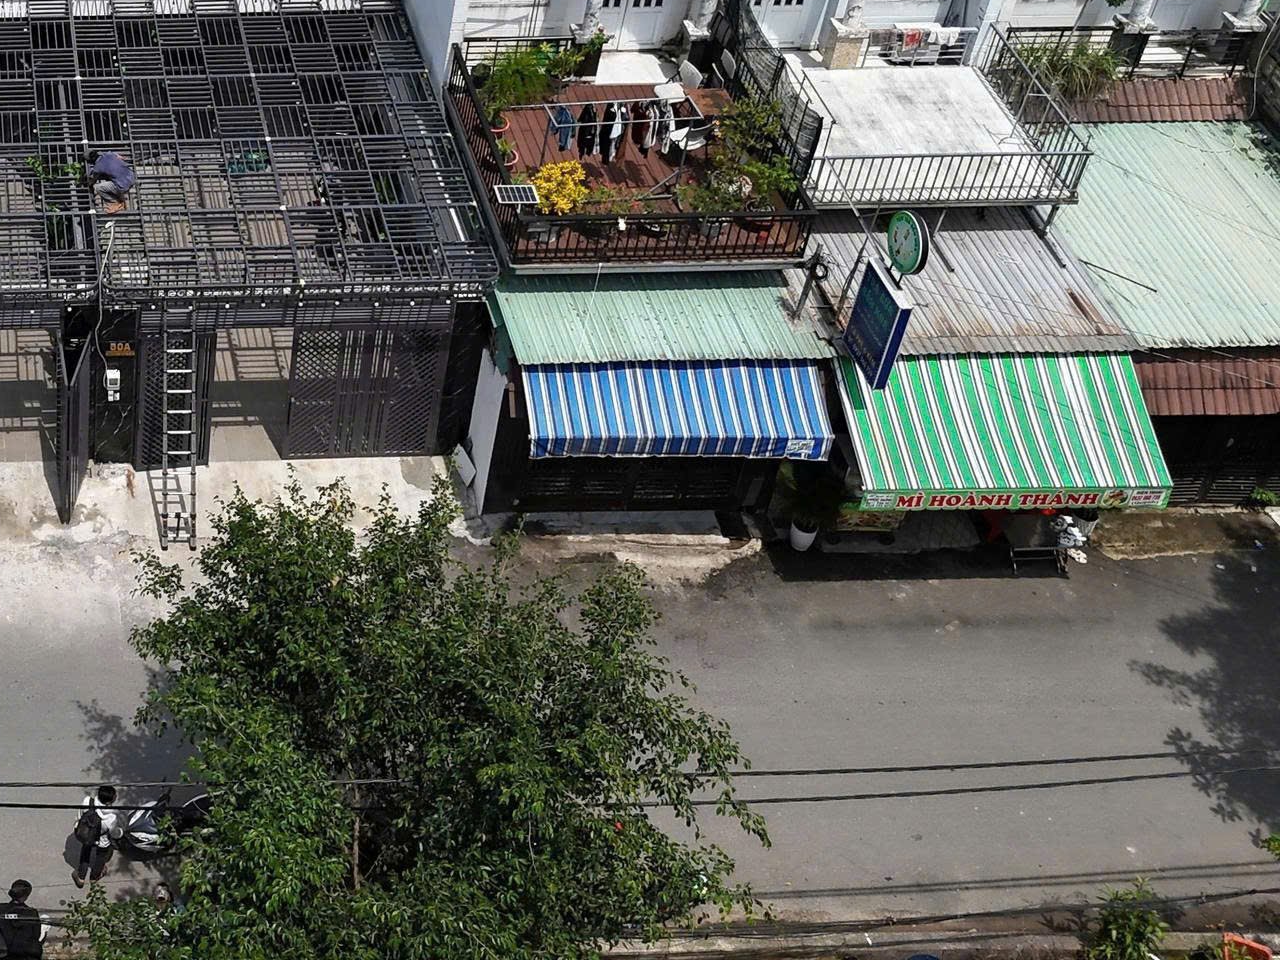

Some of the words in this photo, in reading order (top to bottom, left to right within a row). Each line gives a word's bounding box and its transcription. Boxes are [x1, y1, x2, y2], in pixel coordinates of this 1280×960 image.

[896, 492, 925, 507] MÌ
[928, 491, 1014, 506] HOÀNH
[1019, 490, 1099, 506] THÁNH
